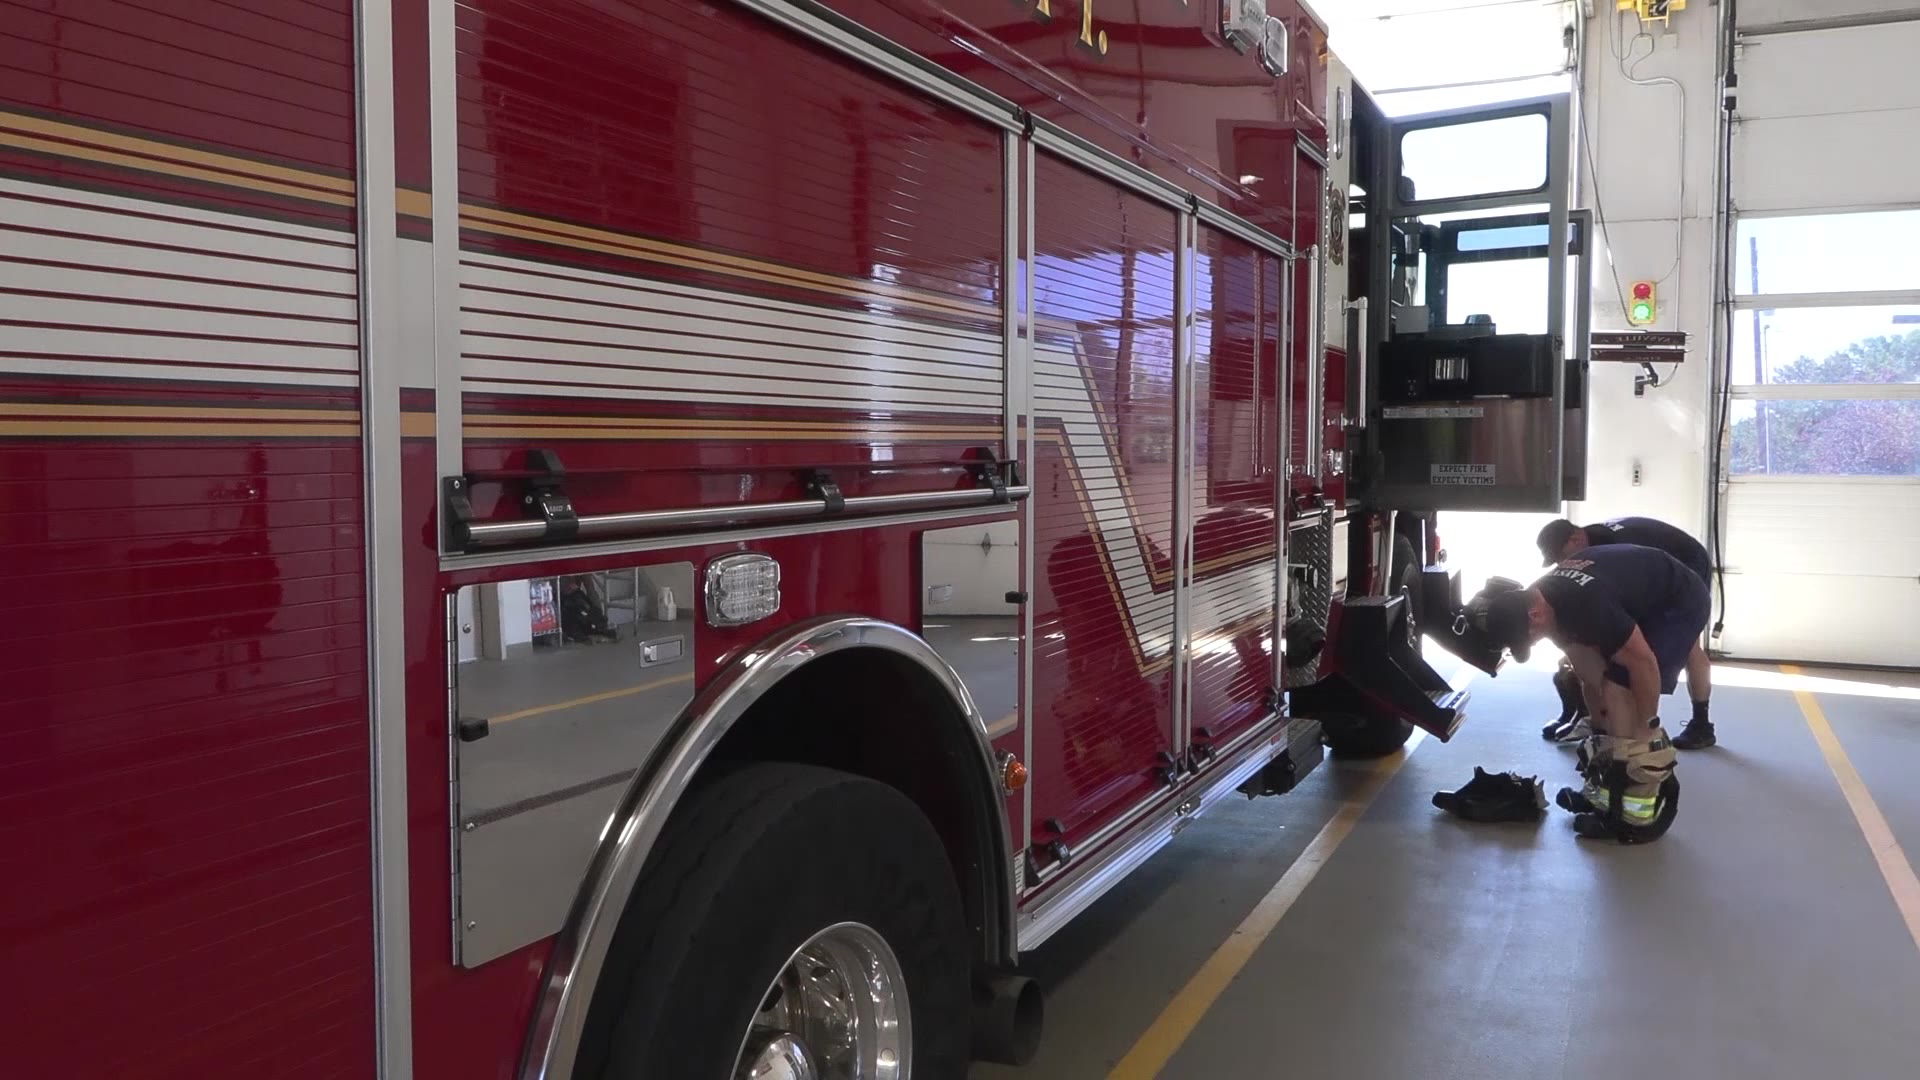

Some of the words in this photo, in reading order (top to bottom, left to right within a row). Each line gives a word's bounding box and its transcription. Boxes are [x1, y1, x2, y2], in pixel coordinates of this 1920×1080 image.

[1439, 464, 1467, 473] EXPECT
[1469, 464, 1488, 473] FIRE
[1432, 476, 1461, 484] EXPECT
[1463, 476, 1494, 485] VICTIMS
